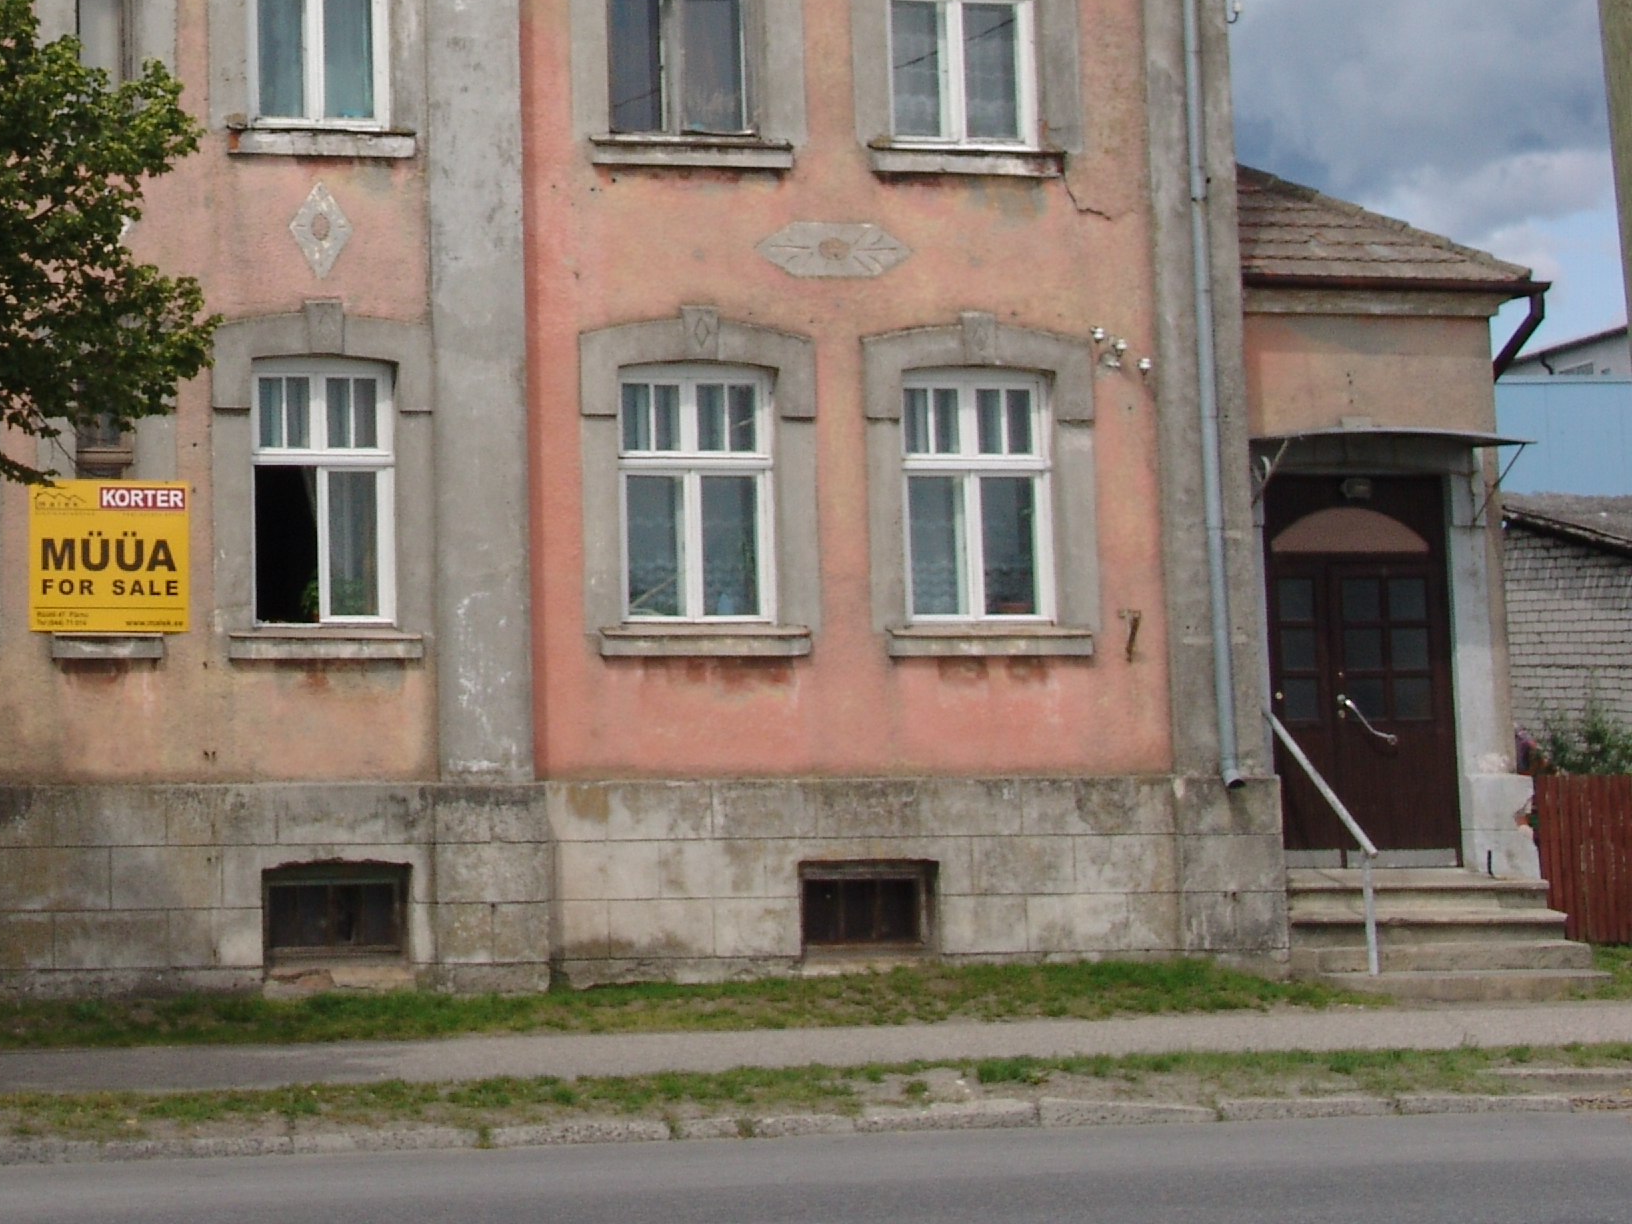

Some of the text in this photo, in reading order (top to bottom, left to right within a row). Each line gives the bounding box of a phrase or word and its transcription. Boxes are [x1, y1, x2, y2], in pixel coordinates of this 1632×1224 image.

[101, 489, 184, 508] KORTER
[41, 530, 177, 572] MÜÜA
[42, 579, 179, 596] FOR SALE
